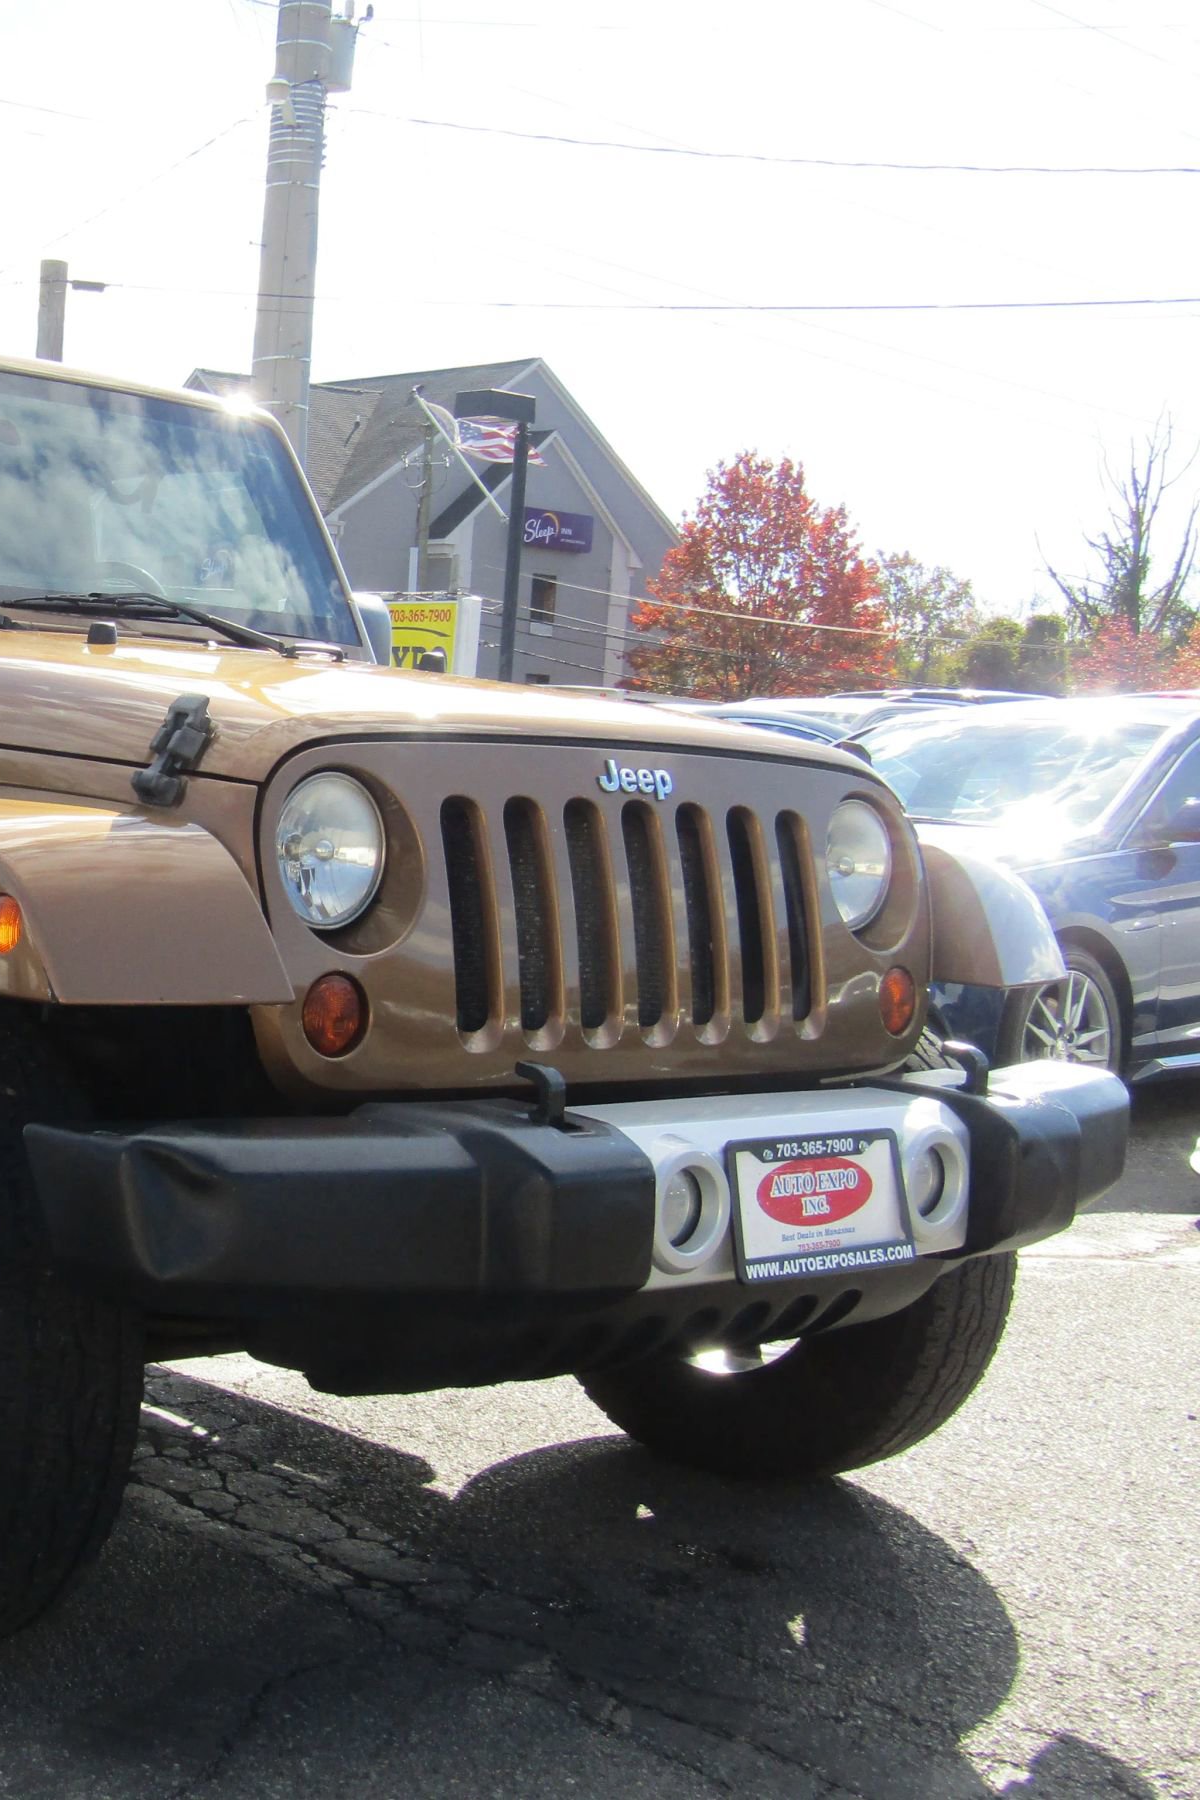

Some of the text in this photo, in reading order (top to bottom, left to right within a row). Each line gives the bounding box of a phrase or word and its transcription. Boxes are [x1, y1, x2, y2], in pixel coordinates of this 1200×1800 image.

[524, 519, 555, 544] Sleep
[390, 609, 451, 622] 703-365-7900
[597, 759, 673, 801] Jeep
[776, 1138, 853, 1157] 703-365-7900
[771, 1168, 857, 1197] AUTO EXPO
[801, 1195, 830, 1216] INC.
[746, 1245, 913, 1279] WWW.AUTOEXPOSALES.COM
